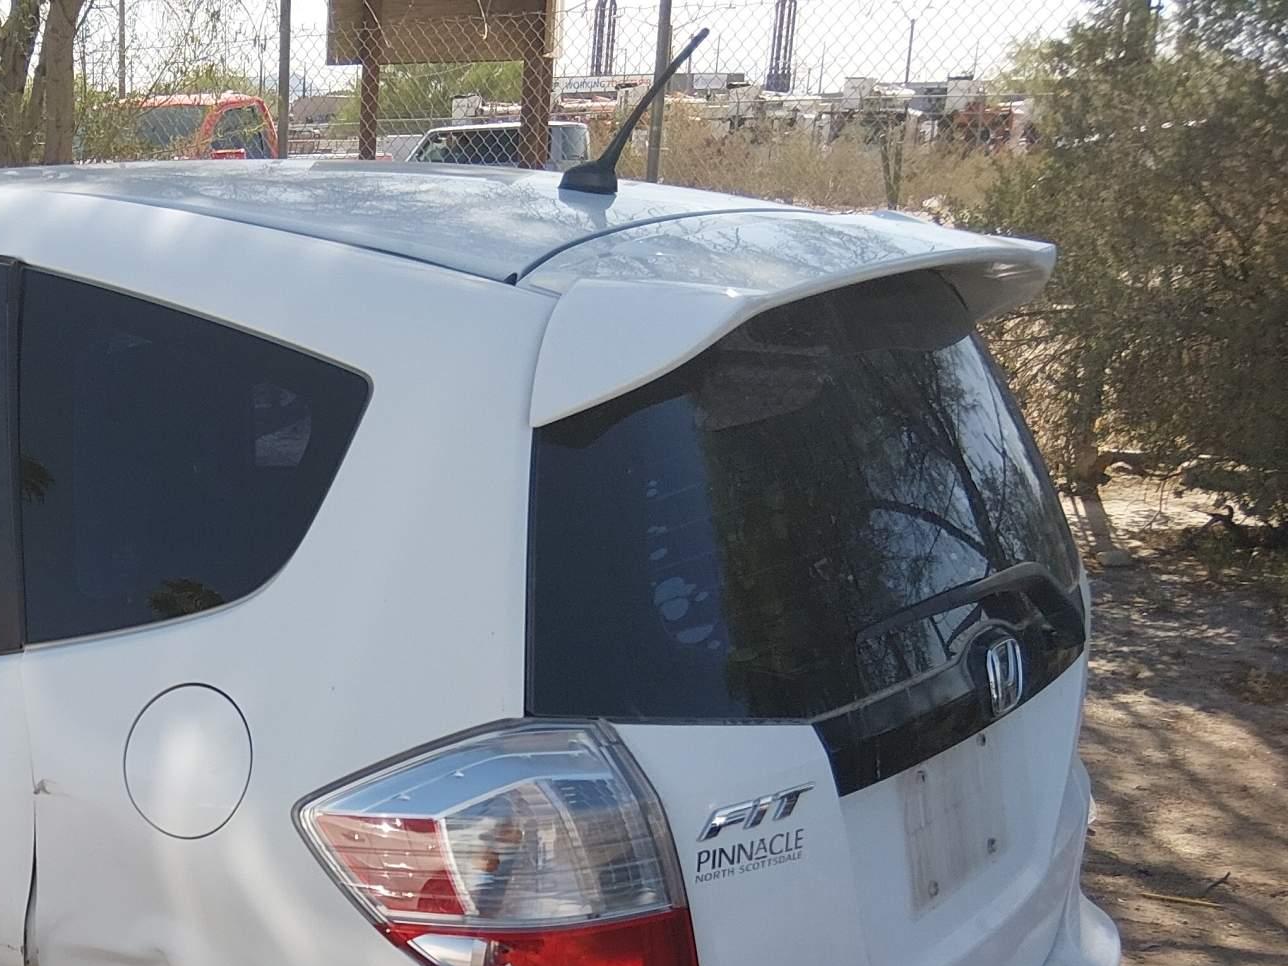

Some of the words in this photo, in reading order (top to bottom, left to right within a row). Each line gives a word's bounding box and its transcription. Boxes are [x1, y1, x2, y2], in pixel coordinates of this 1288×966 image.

[696, 781, 816, 842] FIT
[695, 868, 735, 883] NORTH
[739, 851, 803, 874] SCOTTSDALE
[697, 828, 805, 872] PINNACLE
